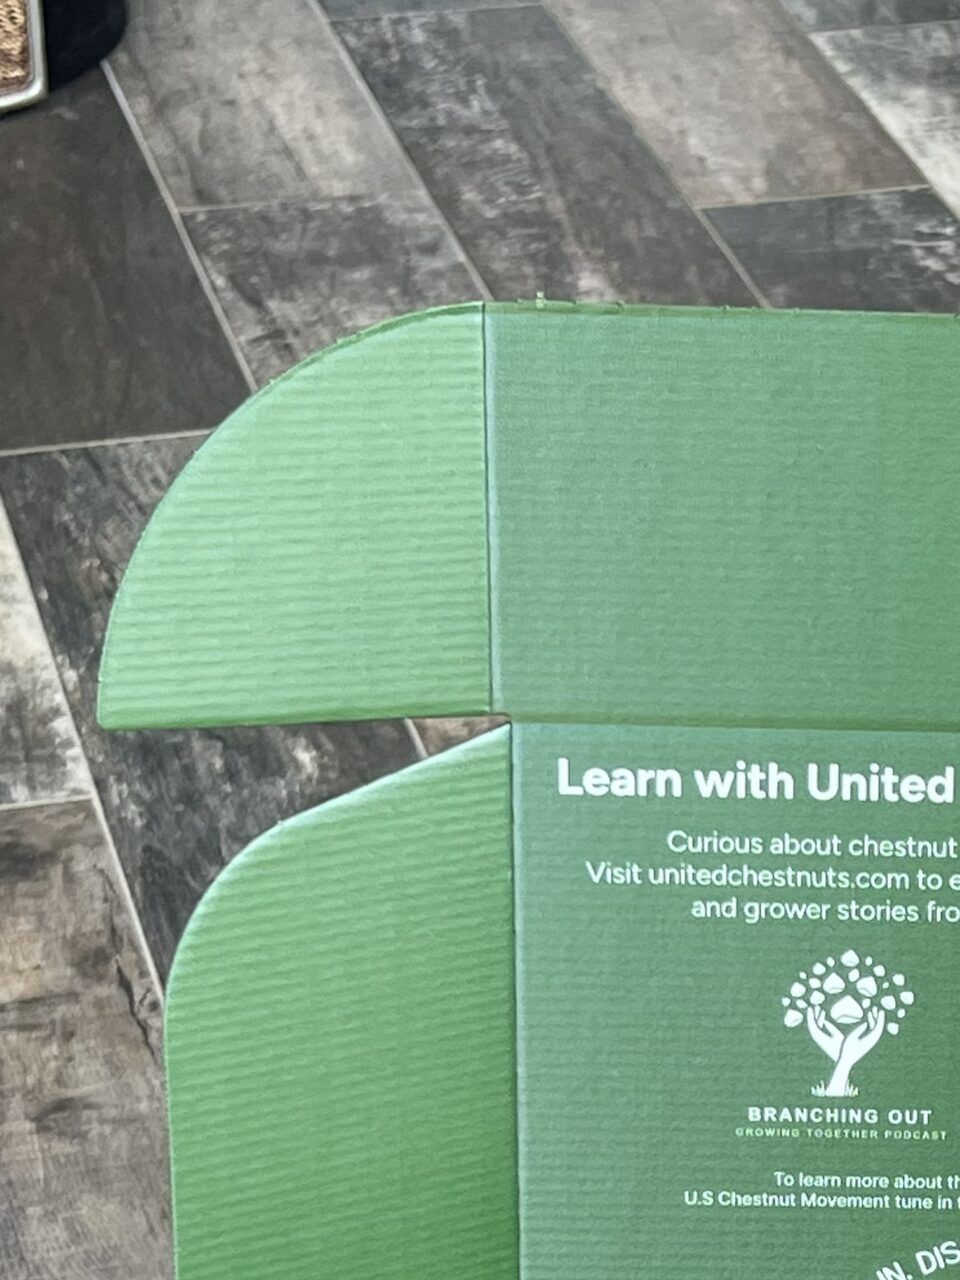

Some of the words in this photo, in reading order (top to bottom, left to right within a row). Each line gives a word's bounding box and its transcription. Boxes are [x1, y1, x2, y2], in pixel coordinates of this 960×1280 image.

[557, 757, 682, 798] Learn
[693, 759, 794, 800] with
[807, 762, 955, 804] United
[666, 830, 763, 855] Curious
[769, 832, 842, 856] about
[848, 833, 958, 859] chestnut
[585, 860, 643, 885] Visit
[648, 862, 910, 890] unitedchestnuts.com
[916, 868, 943, 891] to
[691, 896, 737, 919] and
[743, 901, 831, 924] grower
[837, 899, 920, 922] stories
[747, 1106, 879, 1124] BRANCHING
[887, 1109, 932, 1125] OUT
[735, 1127, 800, 1138] GROWING
[807, 1128, 879, 1139] TOGETHER
[884, 1129, 947, 1141] PODCAST
[773, 1171, 795, 1187] To
[798, 1171, 842, 1188] learn
[845, 1176, 890, 1189] more
[893, 1173, 943, 1189] about
[684, 1190, 714, 1206] U.S
[717, 1190, 796, 1207] Chestnut
[800, 1192, 890, 1209] Movement
[894, 1194, 934, 1210] tune
[937, 1194, 953, 1210] in
